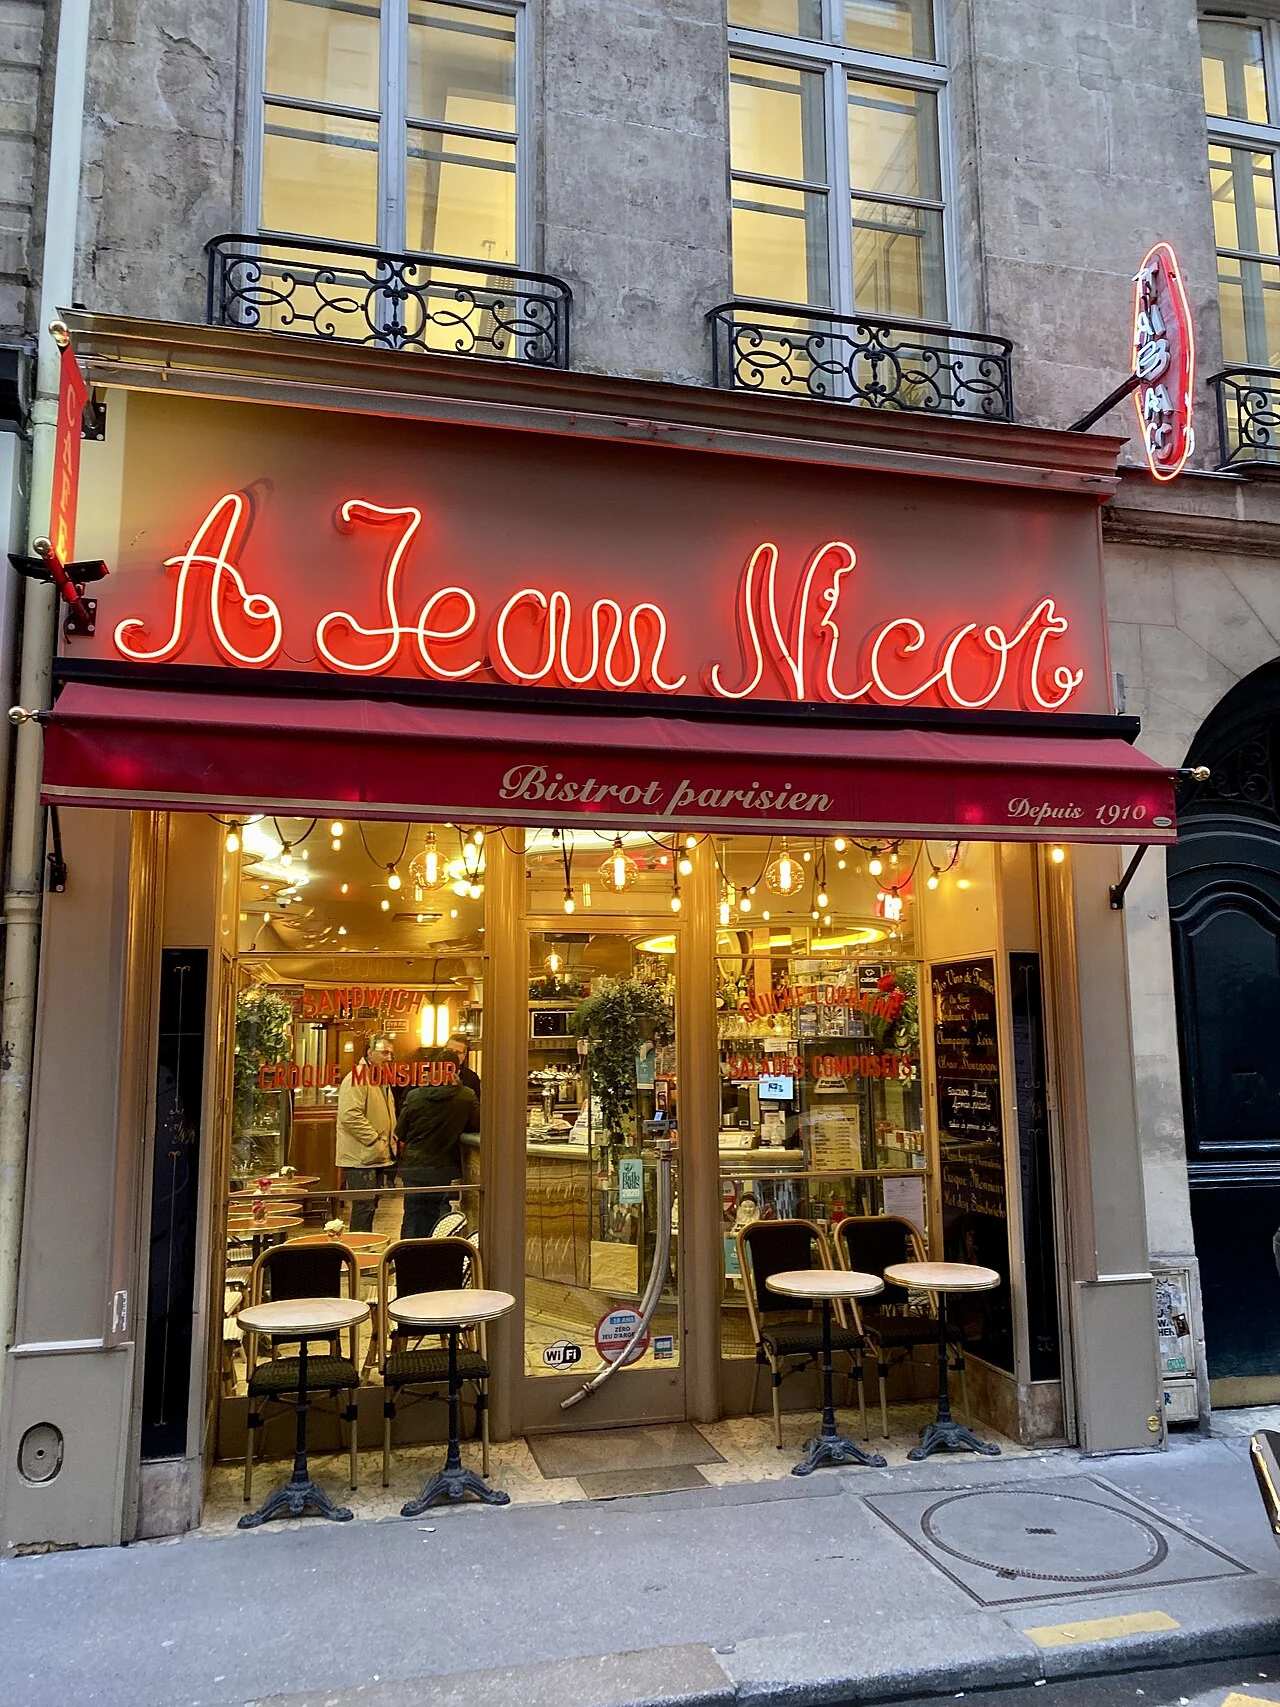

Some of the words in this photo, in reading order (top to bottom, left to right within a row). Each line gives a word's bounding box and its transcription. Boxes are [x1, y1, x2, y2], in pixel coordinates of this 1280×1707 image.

[114, 493, 282, 663] A
[316, 499, 687, 690] Jean
[711, 541, 1083, 708] Nicot
[499, 764, 664, 804] Bistrot
[658, 779, 834, 815] parisien
[1007, 797, 1085, 825] Depuis
[1095, 804, 1147, 825] 1910
[302, 986, 424, 1016] SANDWICH
[740, 985, 805, 1023] QUICHE
[259, 1061, 341, 1089] CROQUE
[351, 1060, 458, 1087] MONSIEUR
[728, 1055, 804, 1078] SALADES
